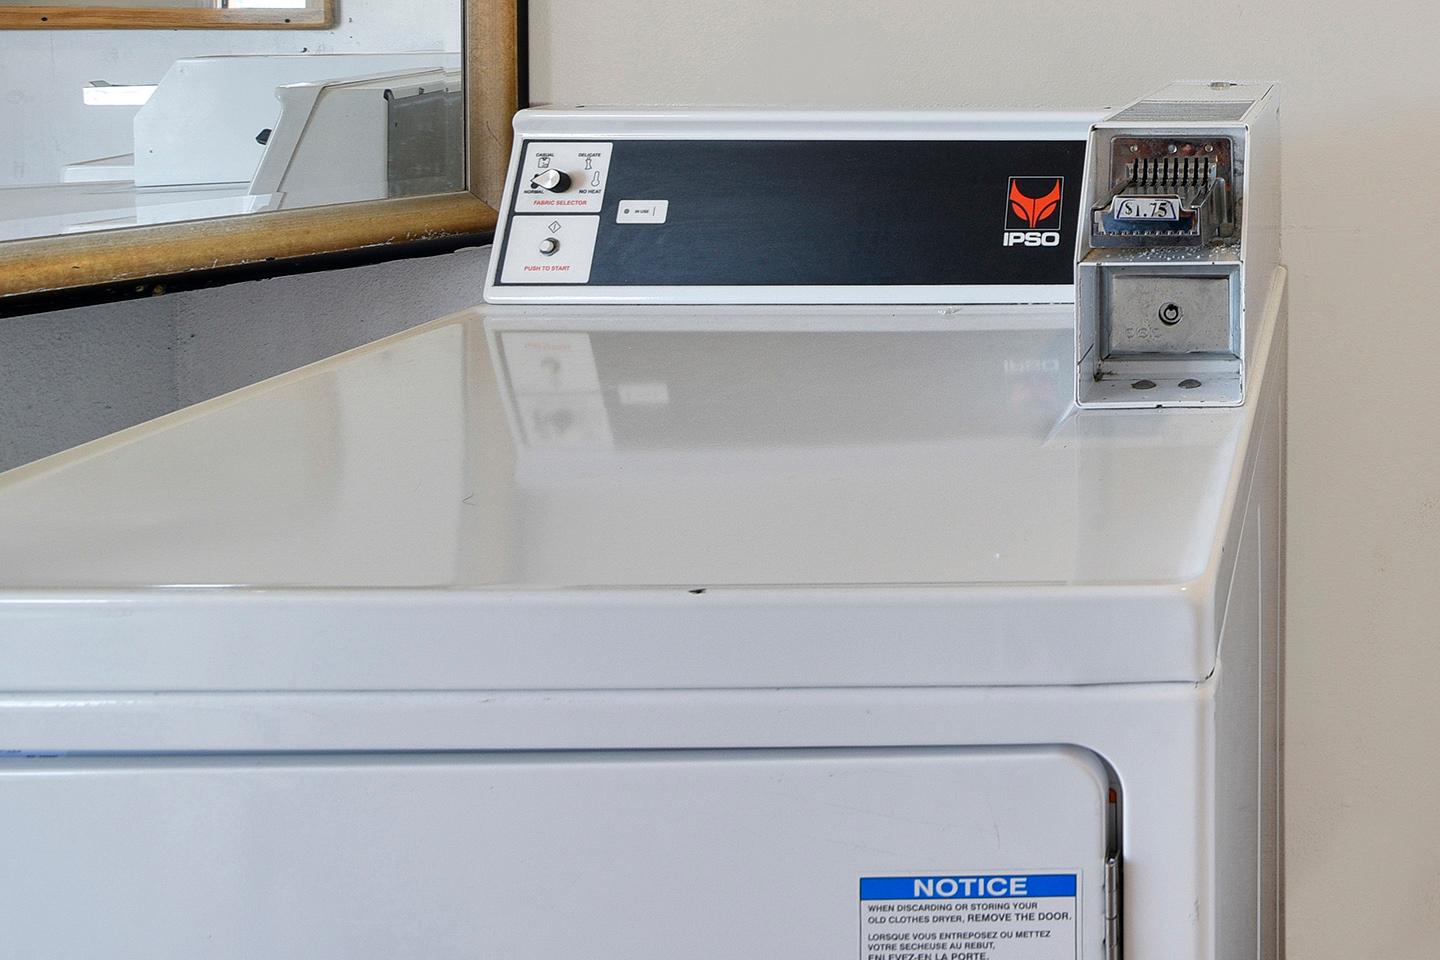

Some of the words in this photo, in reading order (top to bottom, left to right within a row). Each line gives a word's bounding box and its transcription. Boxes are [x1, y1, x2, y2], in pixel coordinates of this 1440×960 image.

[1123, 201, 1169, 218] $1.75
[1003, 232, 1060, 247] IPSO
[913, 877, 1028, 897] NOTICE
[868, 904, 895, 913] WHEN
[896, 903, 953, 912] DISCARDING
[955, 903, 969, 911] OR
[970, 902, 1010, 911] STORING
[1012, 902, 1038, 910] YOUR
[868, 915, 886, 924] OLD
[888, 915, 930, 924] CLOTHES
[932, 914, 965, 924] DRYER,
[967, 913, 1012, 923] REMOVE
[1015, 913, 1035, 922] THE
[1038, 912, 1072, 921] DOOR.
[868, 932, 910, 941] LORSQUE
[912, 932, 937, 941] VOUS
[939, 931, 998, 940] ENTREPOSEZ
[1000, 931, 1013, 939] OU
[1015, 930, 1051, 939] METTEZ
[868, 943, 897, 951] VOTRE
[899, 942, 947, 951] SECHEUSE
[949, 942, 962, 950] AU
[964, 941, 996, 950] REBUT,
